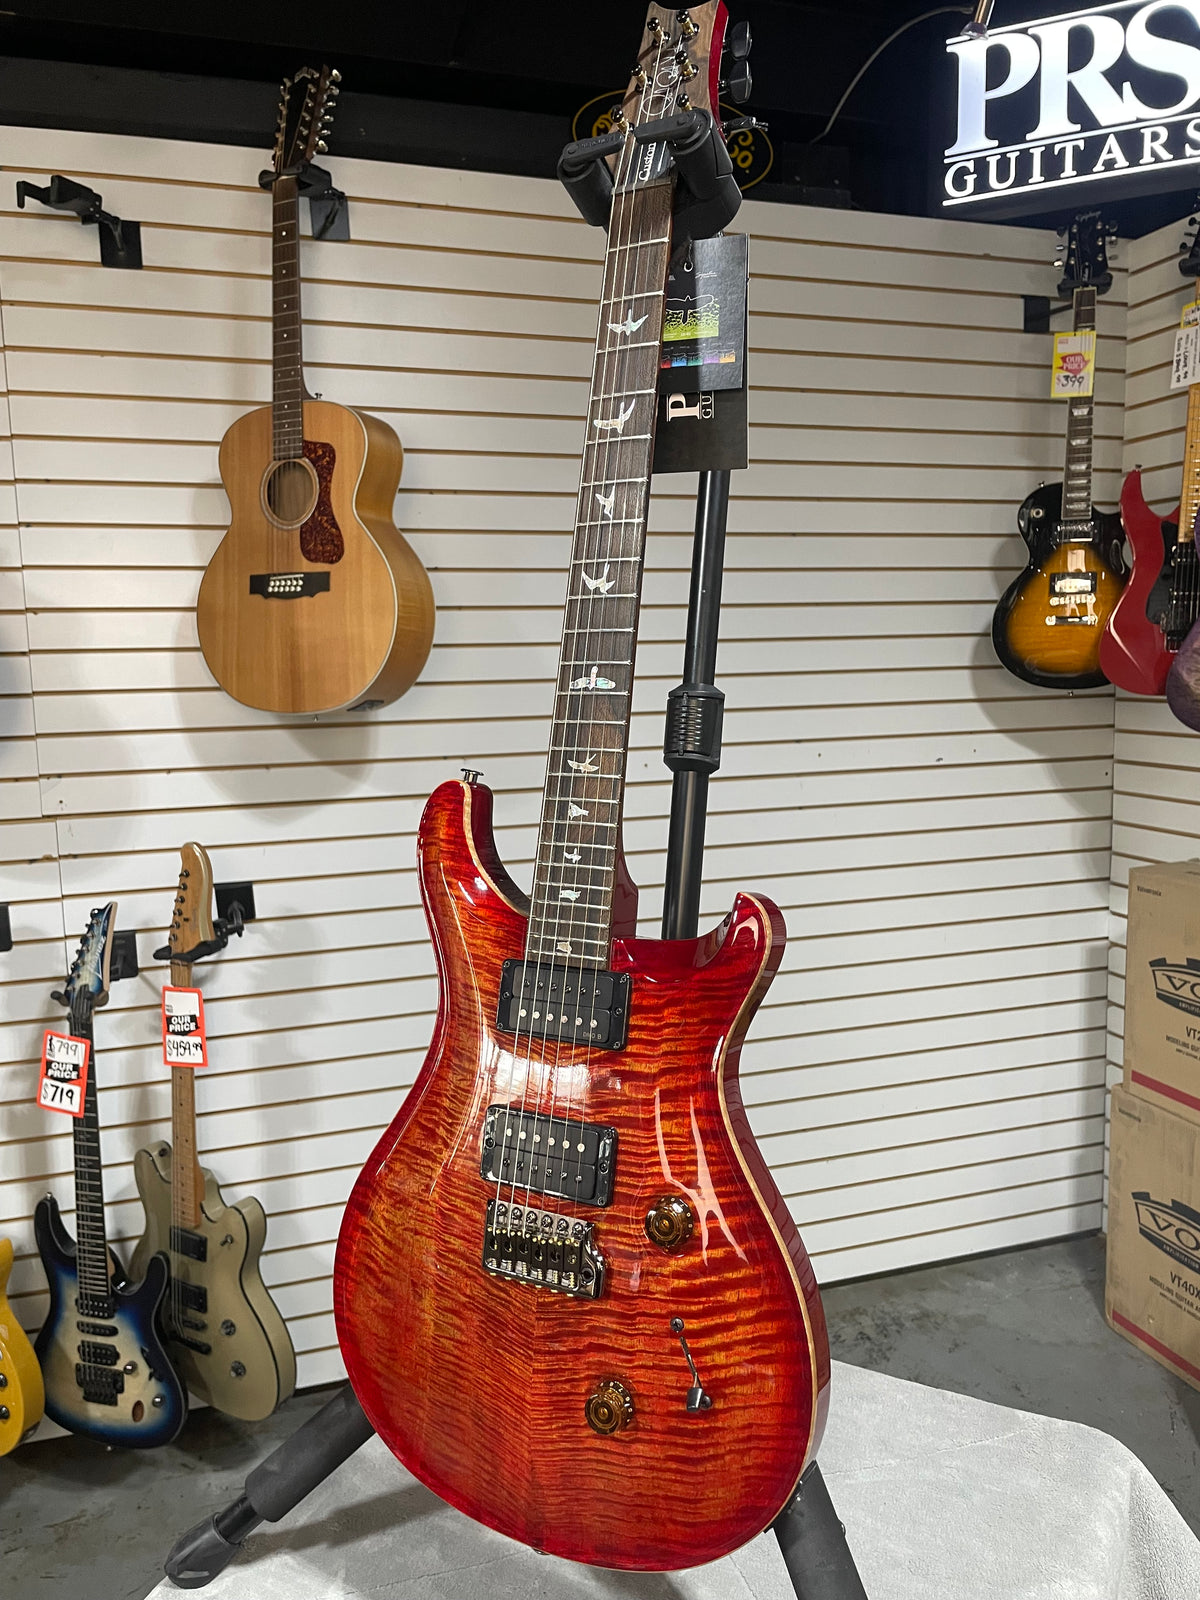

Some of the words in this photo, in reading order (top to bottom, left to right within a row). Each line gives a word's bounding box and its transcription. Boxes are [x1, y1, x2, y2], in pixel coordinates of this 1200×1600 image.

[945, 1, 1200, 156] PRS
[944, 118, 1200, 198] GUITARS
[1056, 374, 1085, 388] $399
[171, 1015, 191, 1024] OUR
[169, 1022, 196, 1032] PRICE
[51, 1061, 74, 1072] OUR
[47, 1068, 78, 1079] PRICE
[43, 1083, 74, 1105] $719
